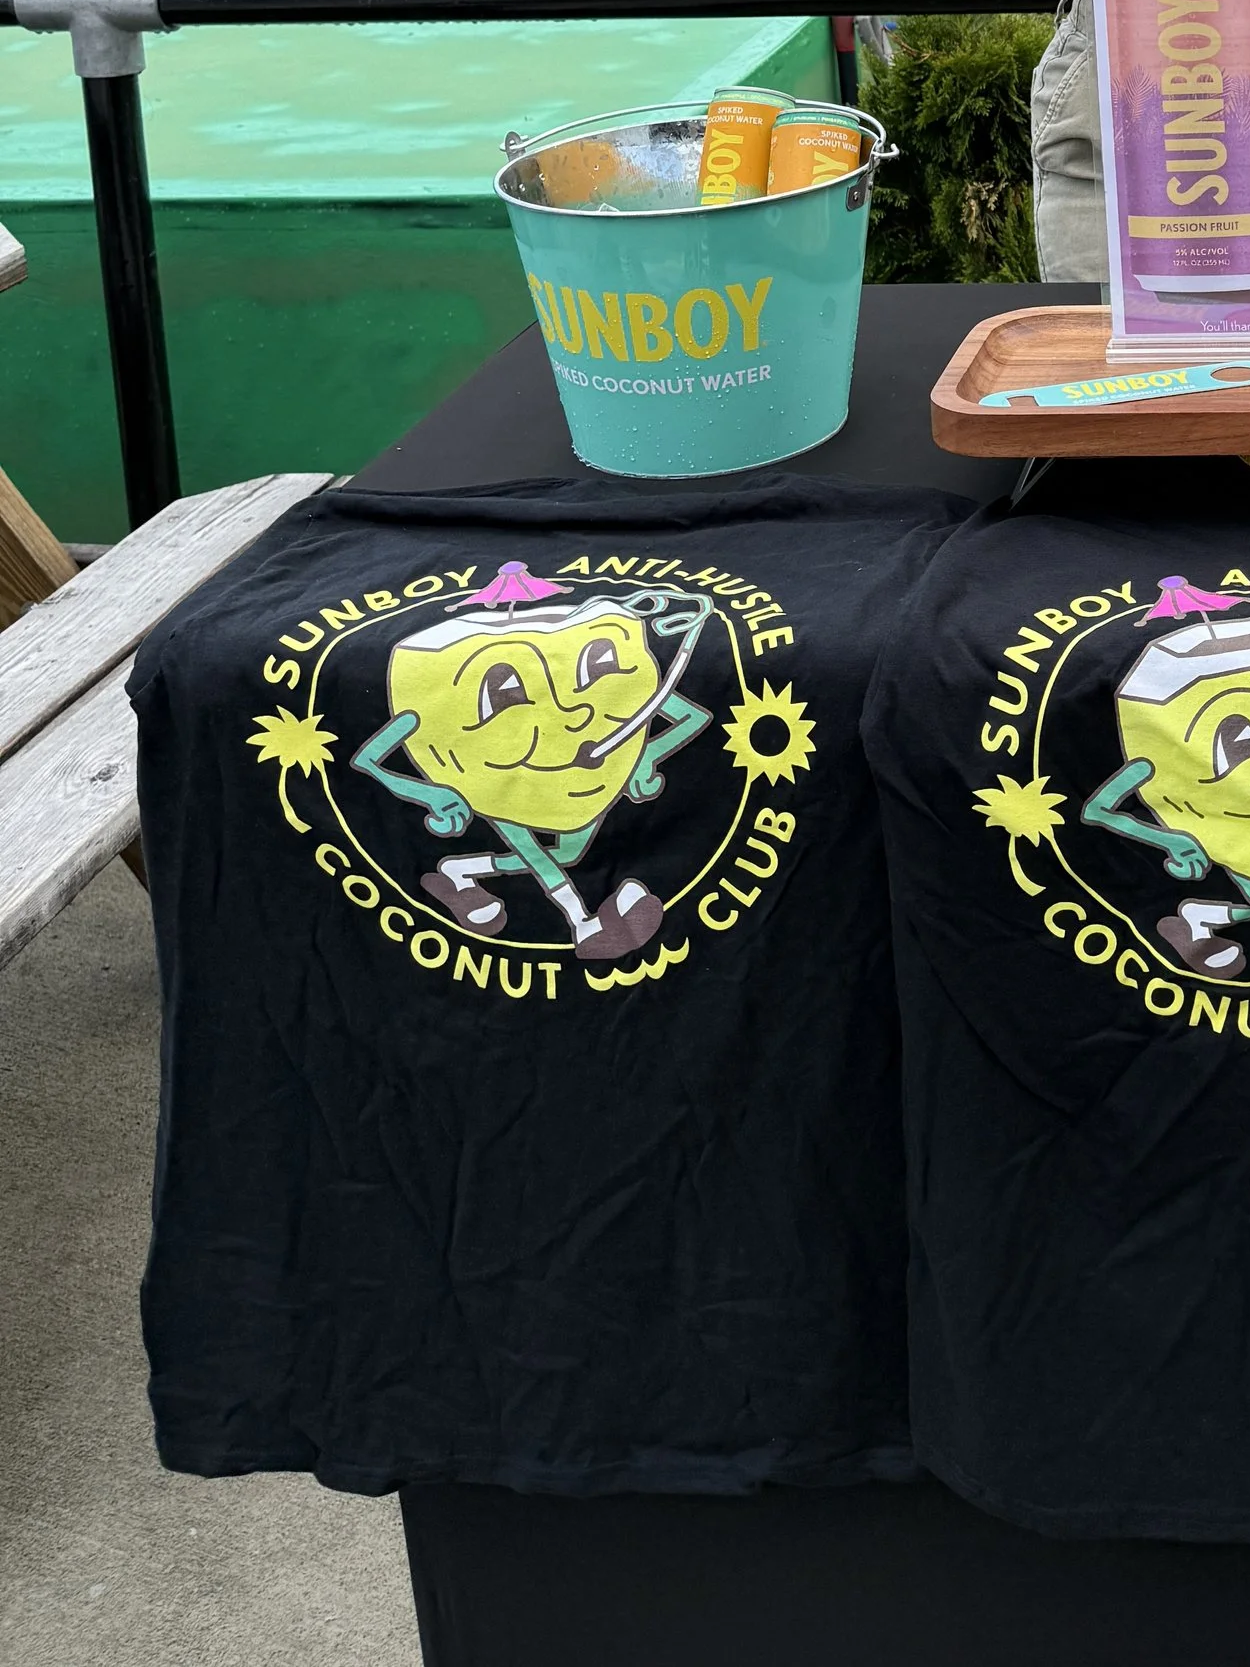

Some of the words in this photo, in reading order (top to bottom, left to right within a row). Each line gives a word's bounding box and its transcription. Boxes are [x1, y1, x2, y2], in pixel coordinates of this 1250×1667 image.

[718, 106, 744, 114] SPIKED
[736, 115, 764, 124] WATER
[821, 130, 848, 140] SPIKED
[798, 138, 841, 148] COCONUT
[1160, 222, 1207, 232] PASSION
[1210, 222, 1239, 232] FRUIT
[1176, 248, 1188, 256] 5%
[1190, 248, 1228, 256] ALC/VOL
[528, 272, 773, 362] SUNBOY
[1200, 320, 1228, 332] You'll
[592, 376, 695, 394] COCONUT
[701, 364, 772, 392] WATER
[1062, 370, 1188, 399] SUNBOY
[264, 566, 478, 690] SUNBOY
[557, 556, 794, 656] ANTI-HUSTLE
[981, 580, 1138, 756] SUNBOY
[315, 844, 562, 1000] COCONUT
[698, 806, 797, 931] CLUB
